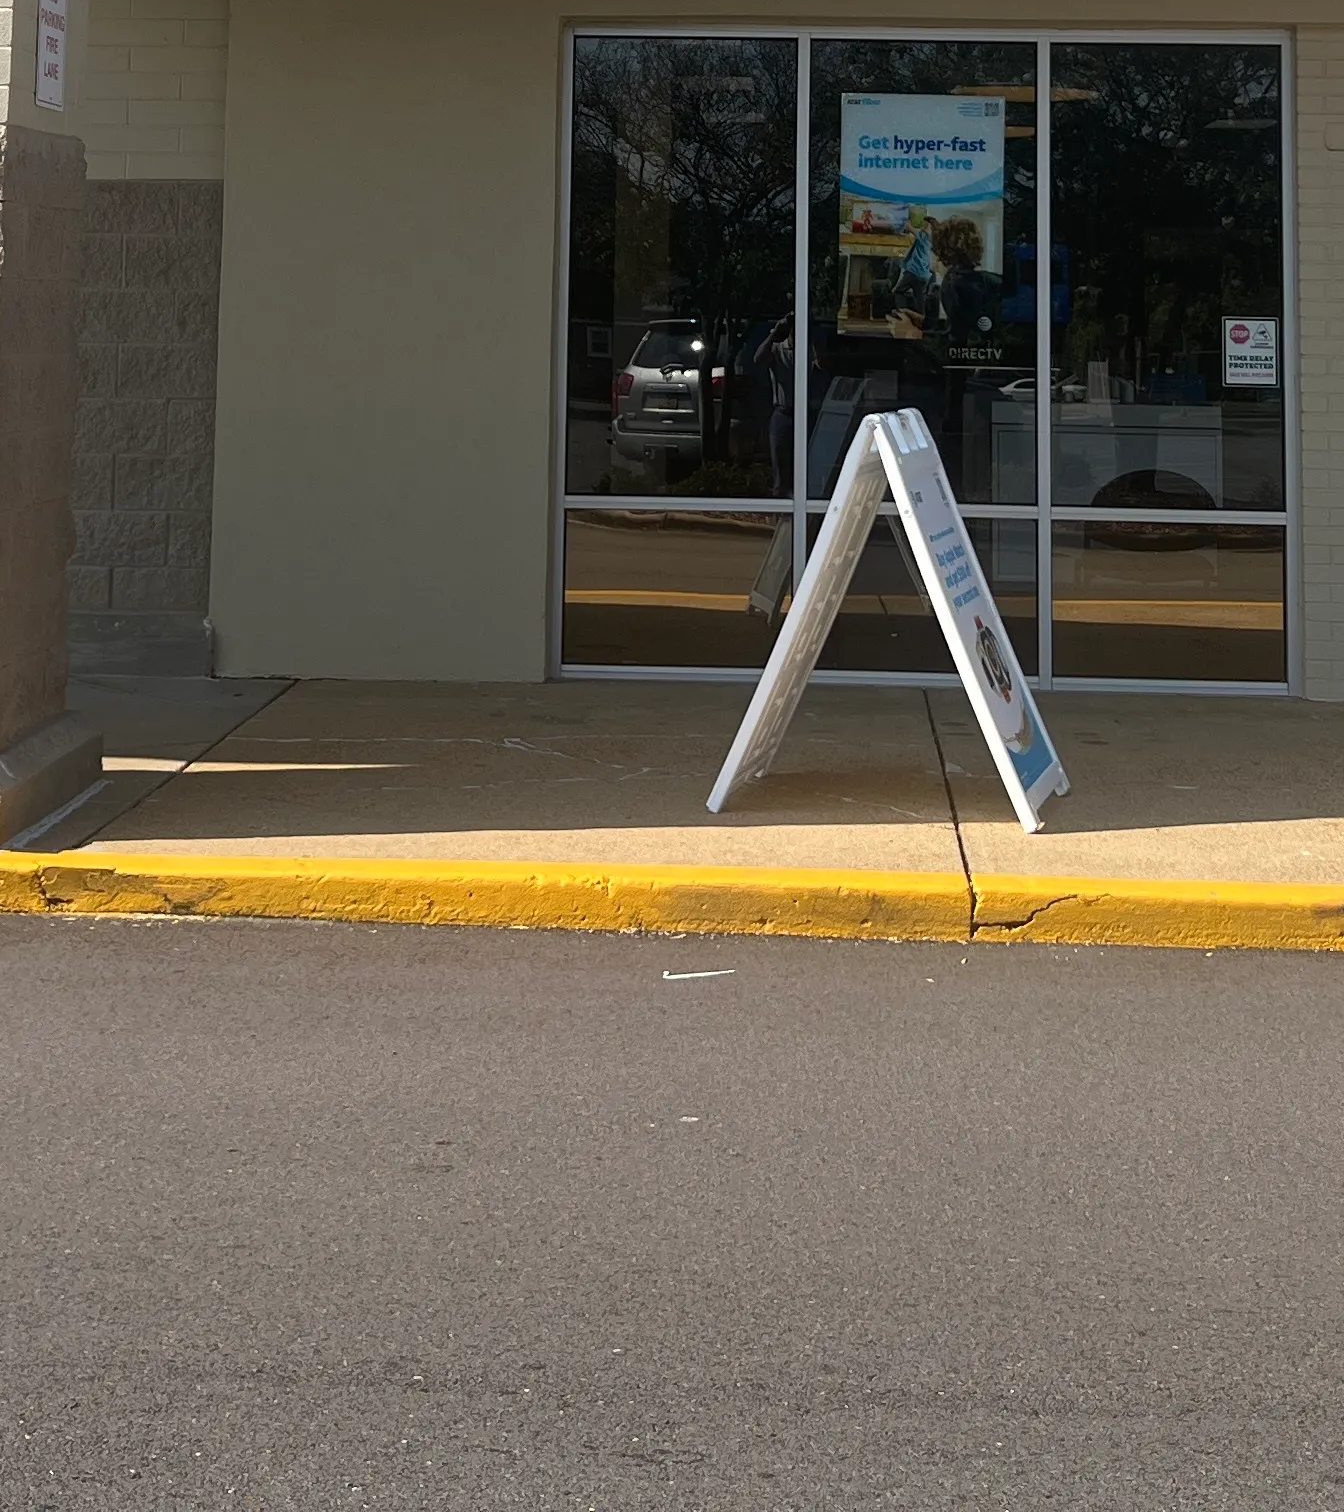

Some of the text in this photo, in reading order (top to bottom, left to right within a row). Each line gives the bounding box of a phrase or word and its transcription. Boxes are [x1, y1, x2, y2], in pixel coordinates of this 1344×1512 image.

[41, 7, 65, 32] PARKING
[45, 35, 59, 55] FIRE
[43, 60, 59, 80] LANE
[858, 135, 986, 154] Get hyper-fast
[858, 153, 973, 170] internet here
[1231, 330, 1249, 338] STOP
[948, 347, 1002, 360] DIRECTV
[1228, 362, 1274, 370] PROTECTED
